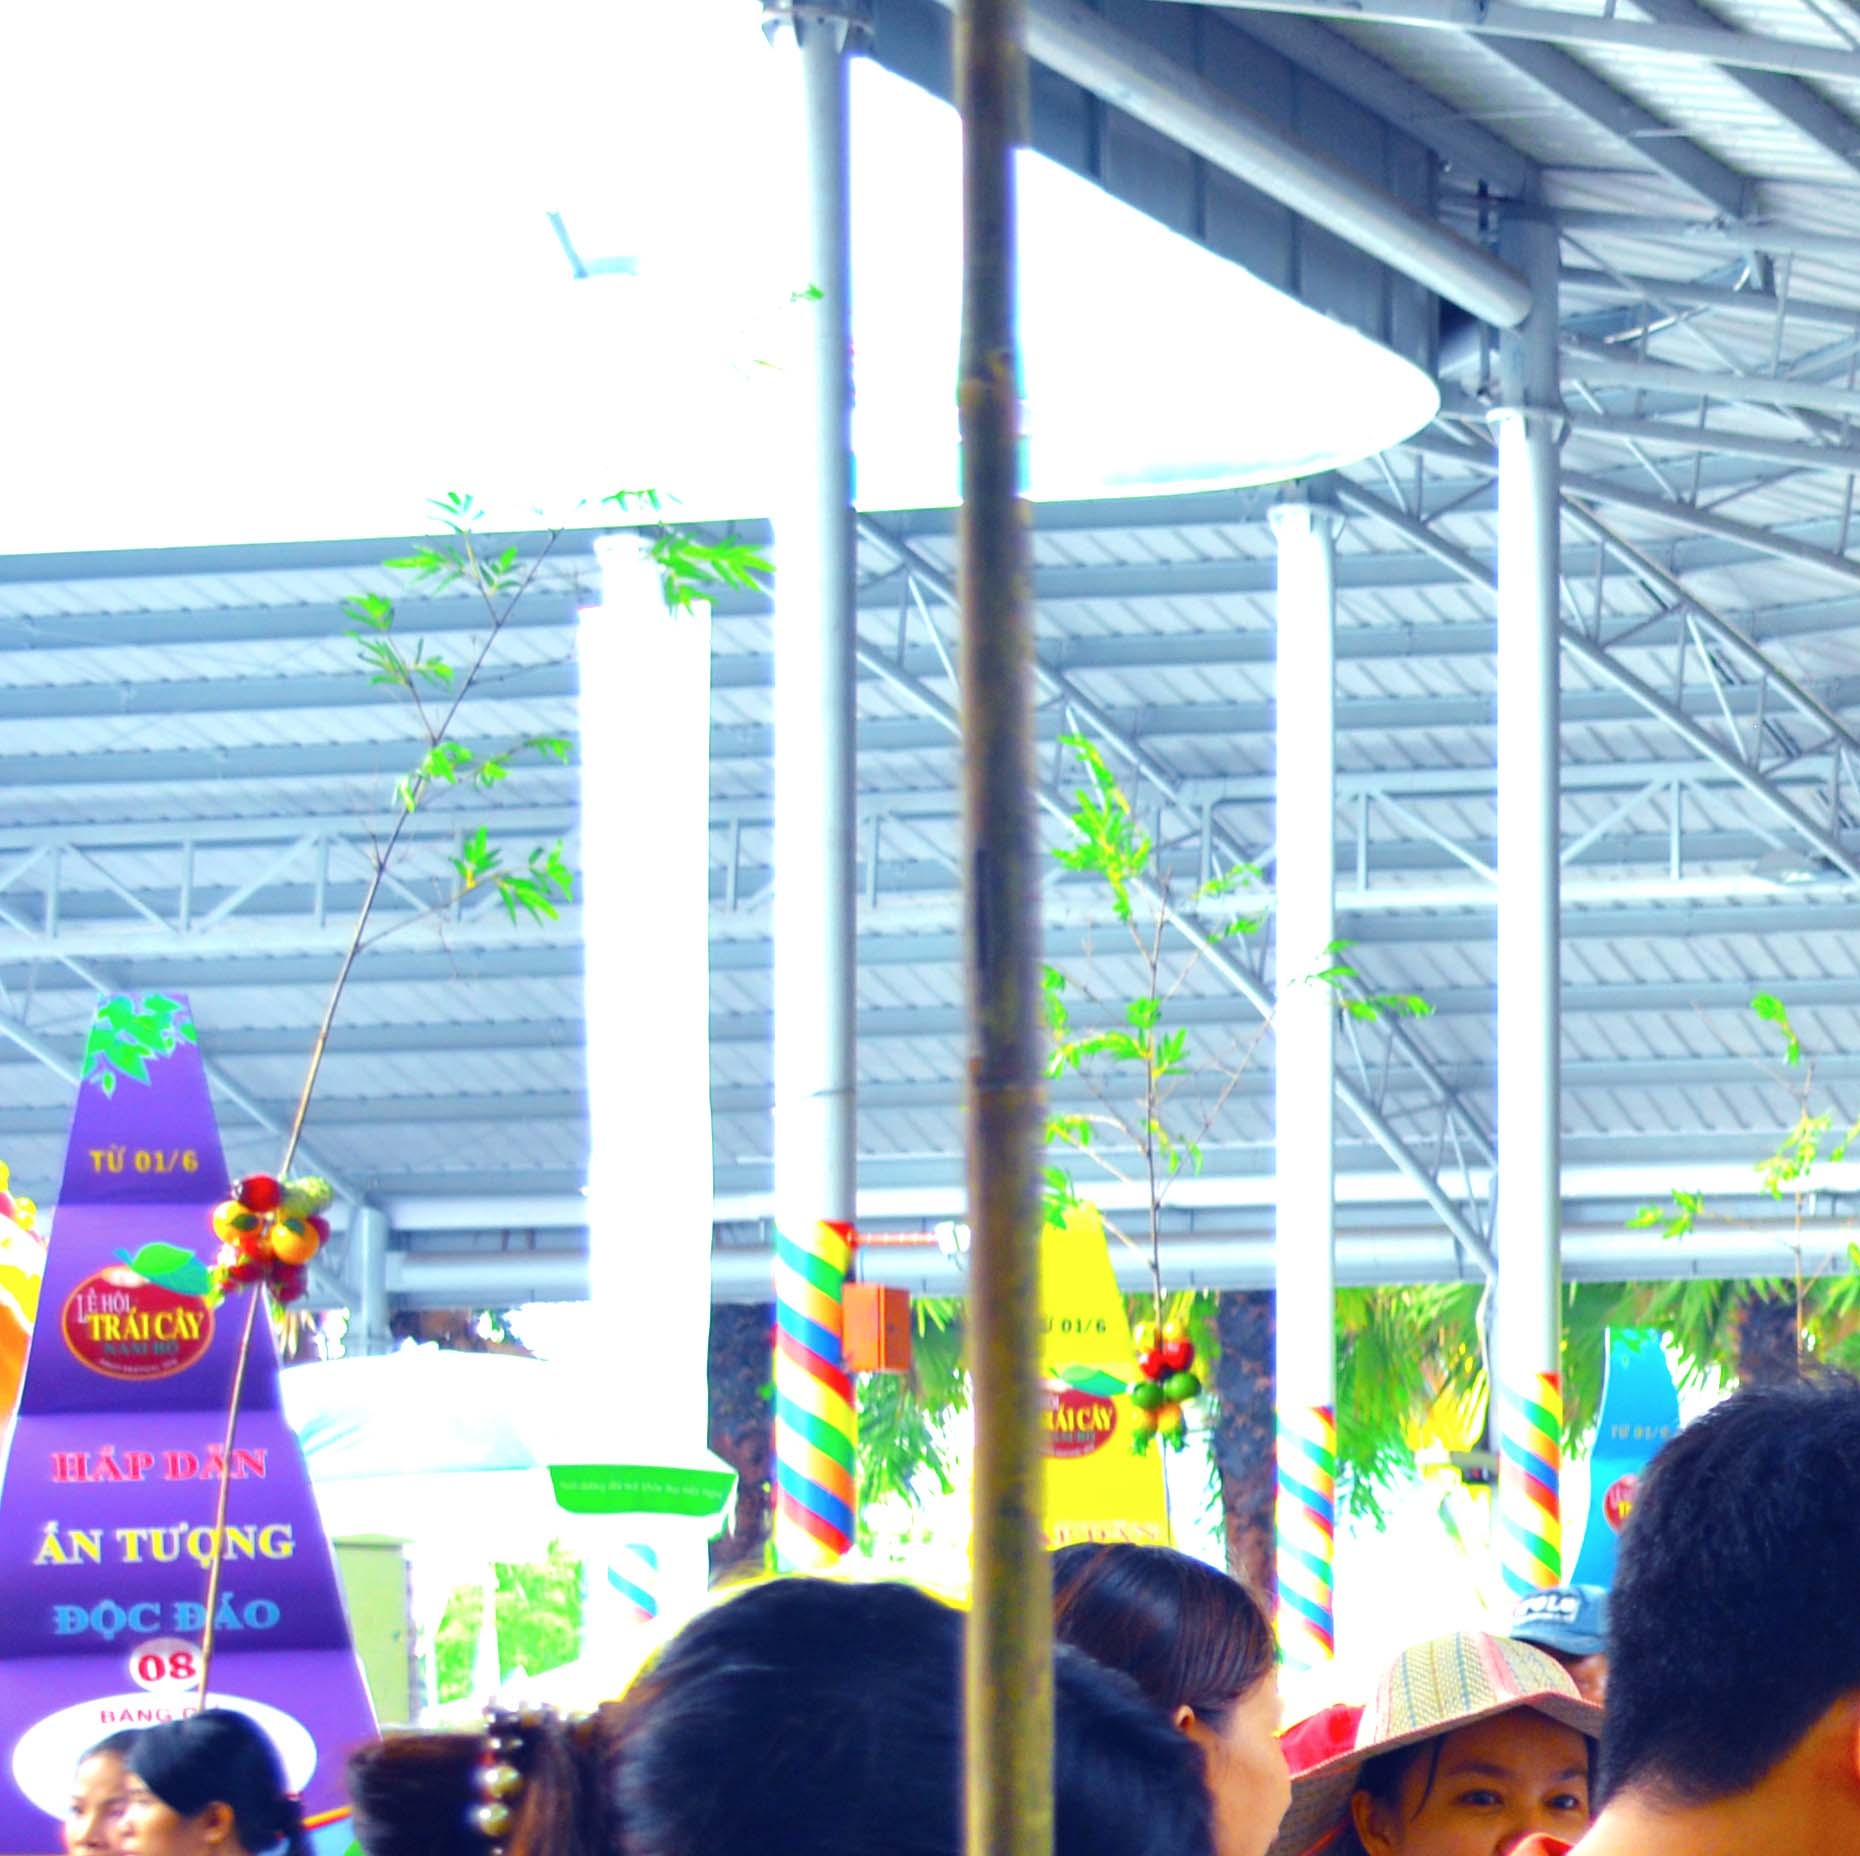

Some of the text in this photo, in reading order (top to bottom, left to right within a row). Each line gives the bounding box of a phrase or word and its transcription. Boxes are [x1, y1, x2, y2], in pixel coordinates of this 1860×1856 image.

[134, 1150, 199, 1173] 01/6
[87, 1306, 205, 1341] TRÁI CÂY
[1061, 1317, 1107, 1334] 01/6
[115, 1521, 296, 1570] TƯỢNG
[53, 1591, 281, 1640] ĐỘC ĐÁO
[137, 1650, 197, 1682] 08
